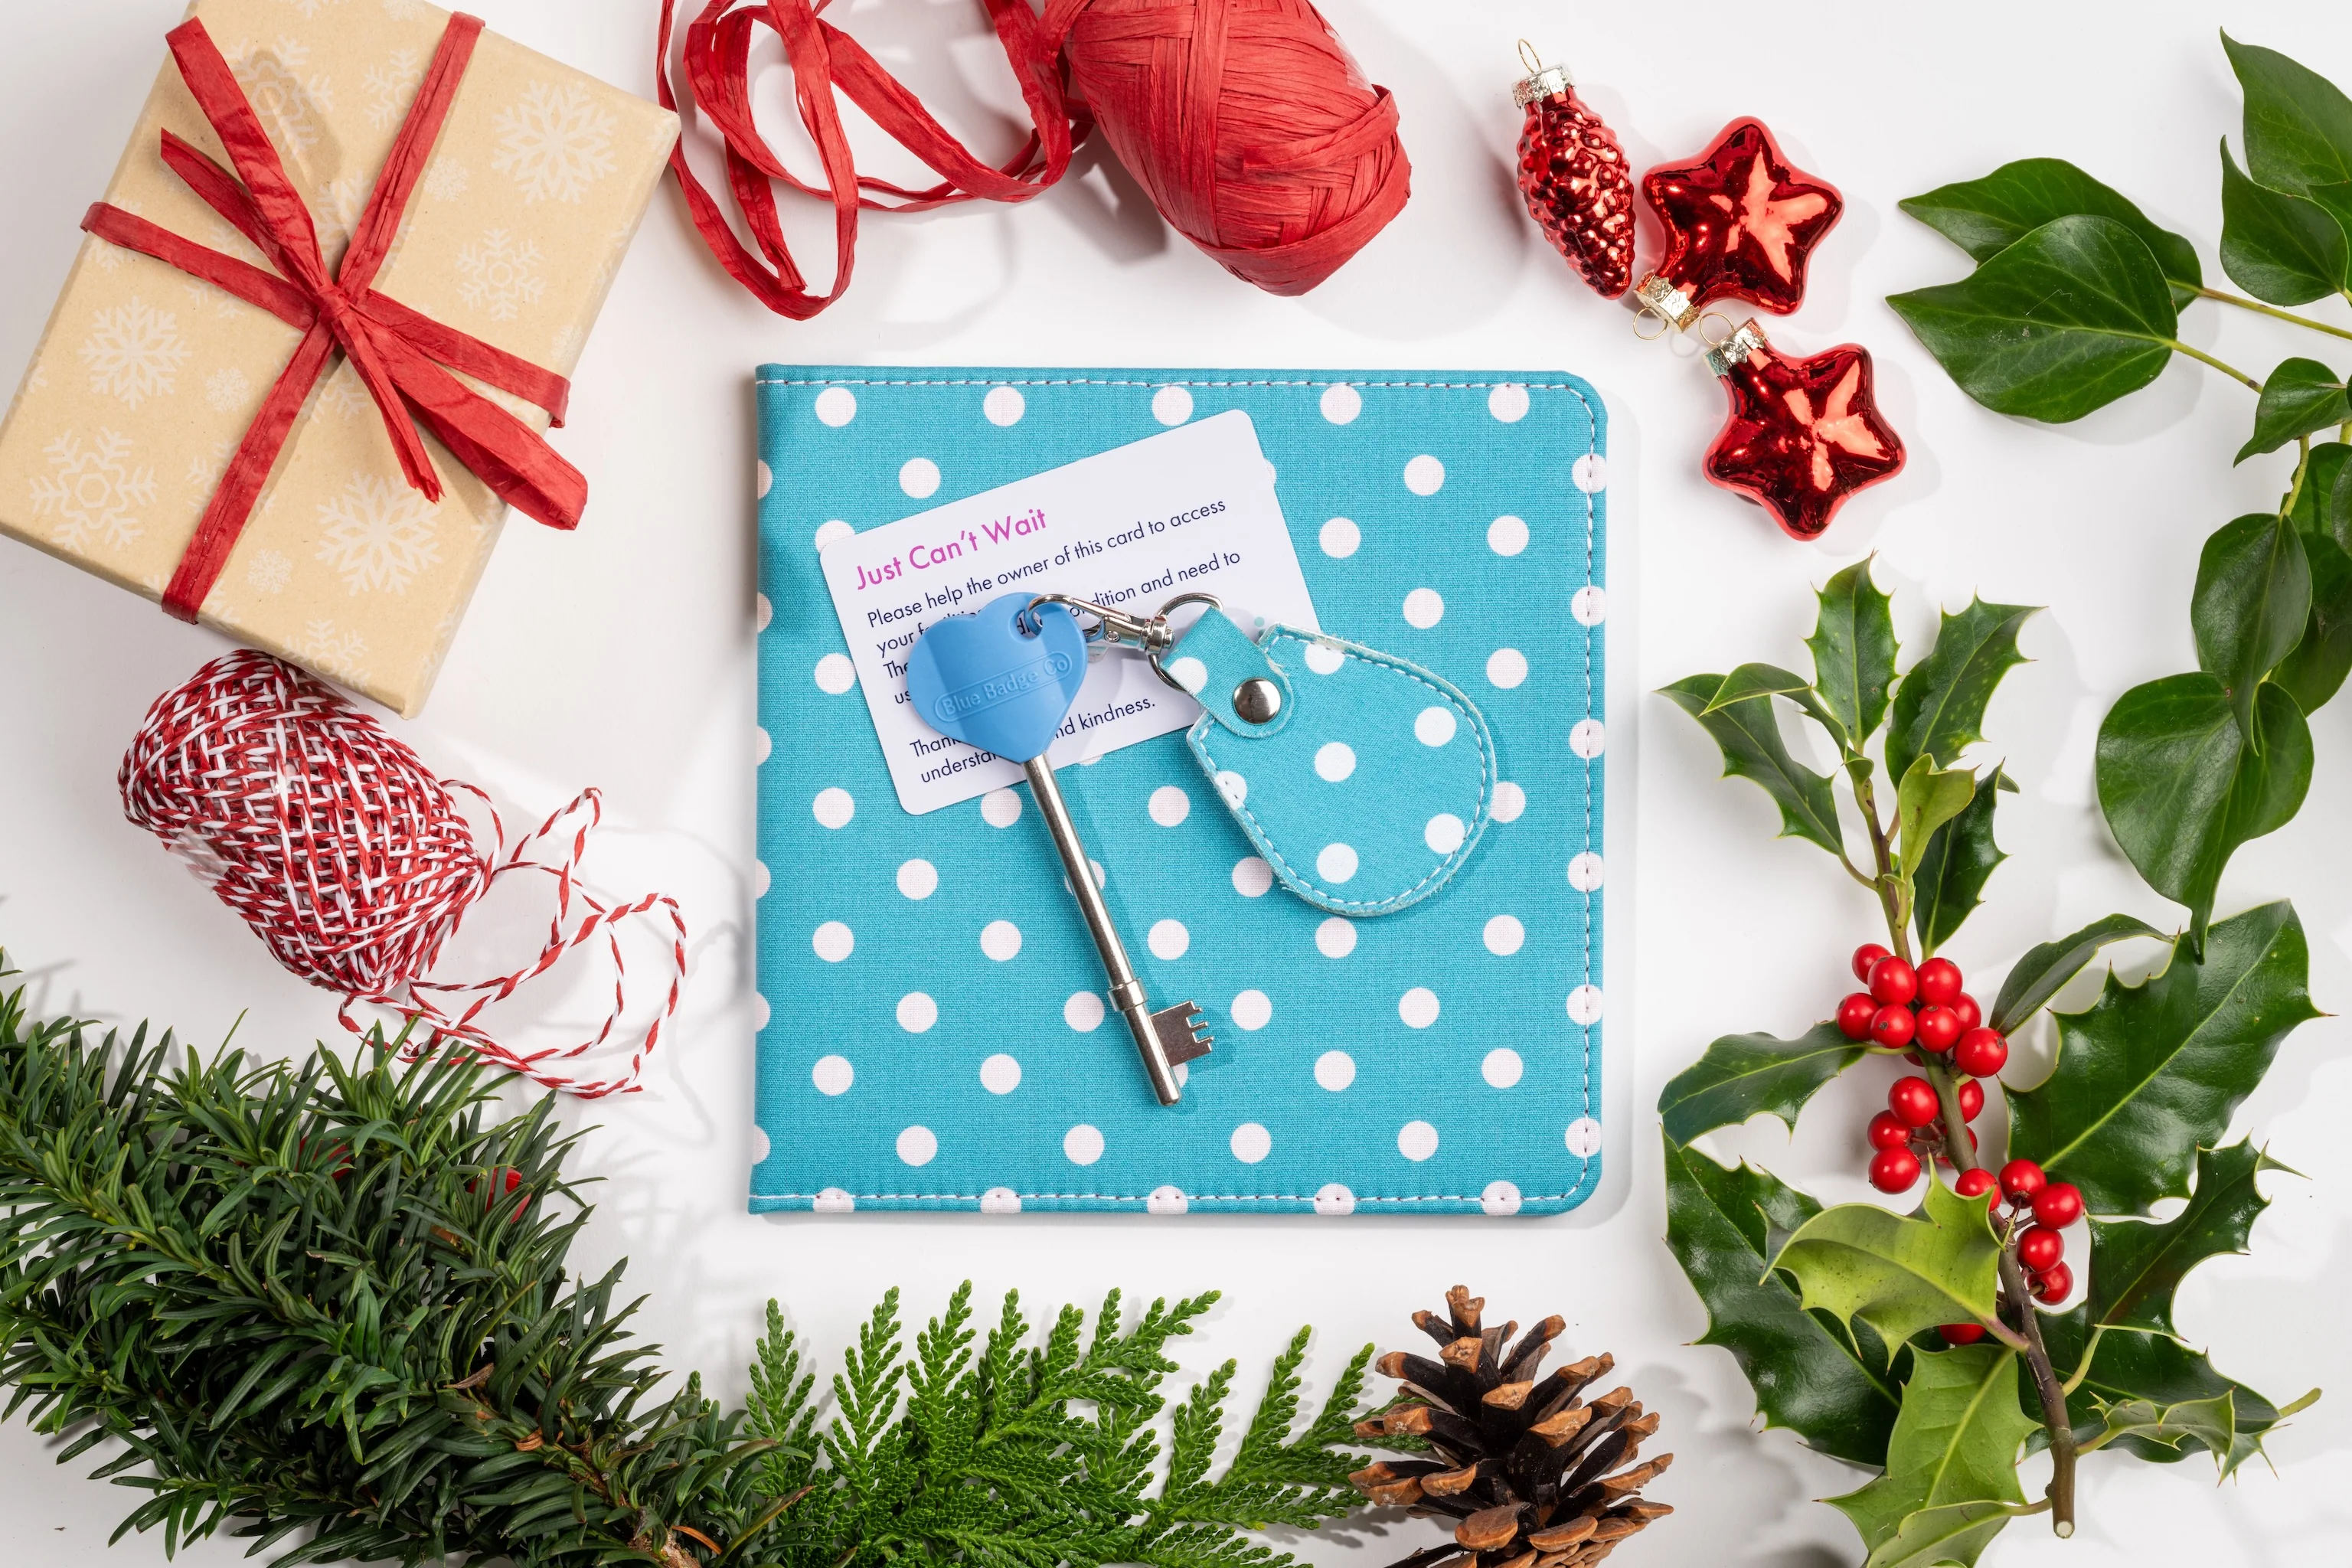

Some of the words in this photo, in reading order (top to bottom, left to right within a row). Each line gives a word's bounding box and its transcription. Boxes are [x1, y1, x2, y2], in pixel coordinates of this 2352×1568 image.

[857, 557, 903, 590] Just
[909, 530, 978, 570] Can't
[981, 508, 1047, 545] Wait
[867, 603, 923, 628] Please
[925, 585, 963, 609] help
[966, 577, 993, 595] the
[998, 559, 1049, 585] owner
[1054, 545, 1070, 566] of
[1074, 540, 1102, 559] this
[1107, 521, 1145, 548] card
[1148, 521, 1165, 534] to
[1170, 501, 1226, 528] access
[1141, 568, 1174, 593] and
[1178, 552, 1220, 582] need
[1223, 552, 1240, 567] to
[876, 632, 915, 658] your
[942, 692, 981, 717] Blue
[983, 671, 1039, 700] Badge
[1044, 658, 1068, 676] Co
[1054, 717, 1076, 740] nd
[1077, 698, 1155, 730] kindness.
